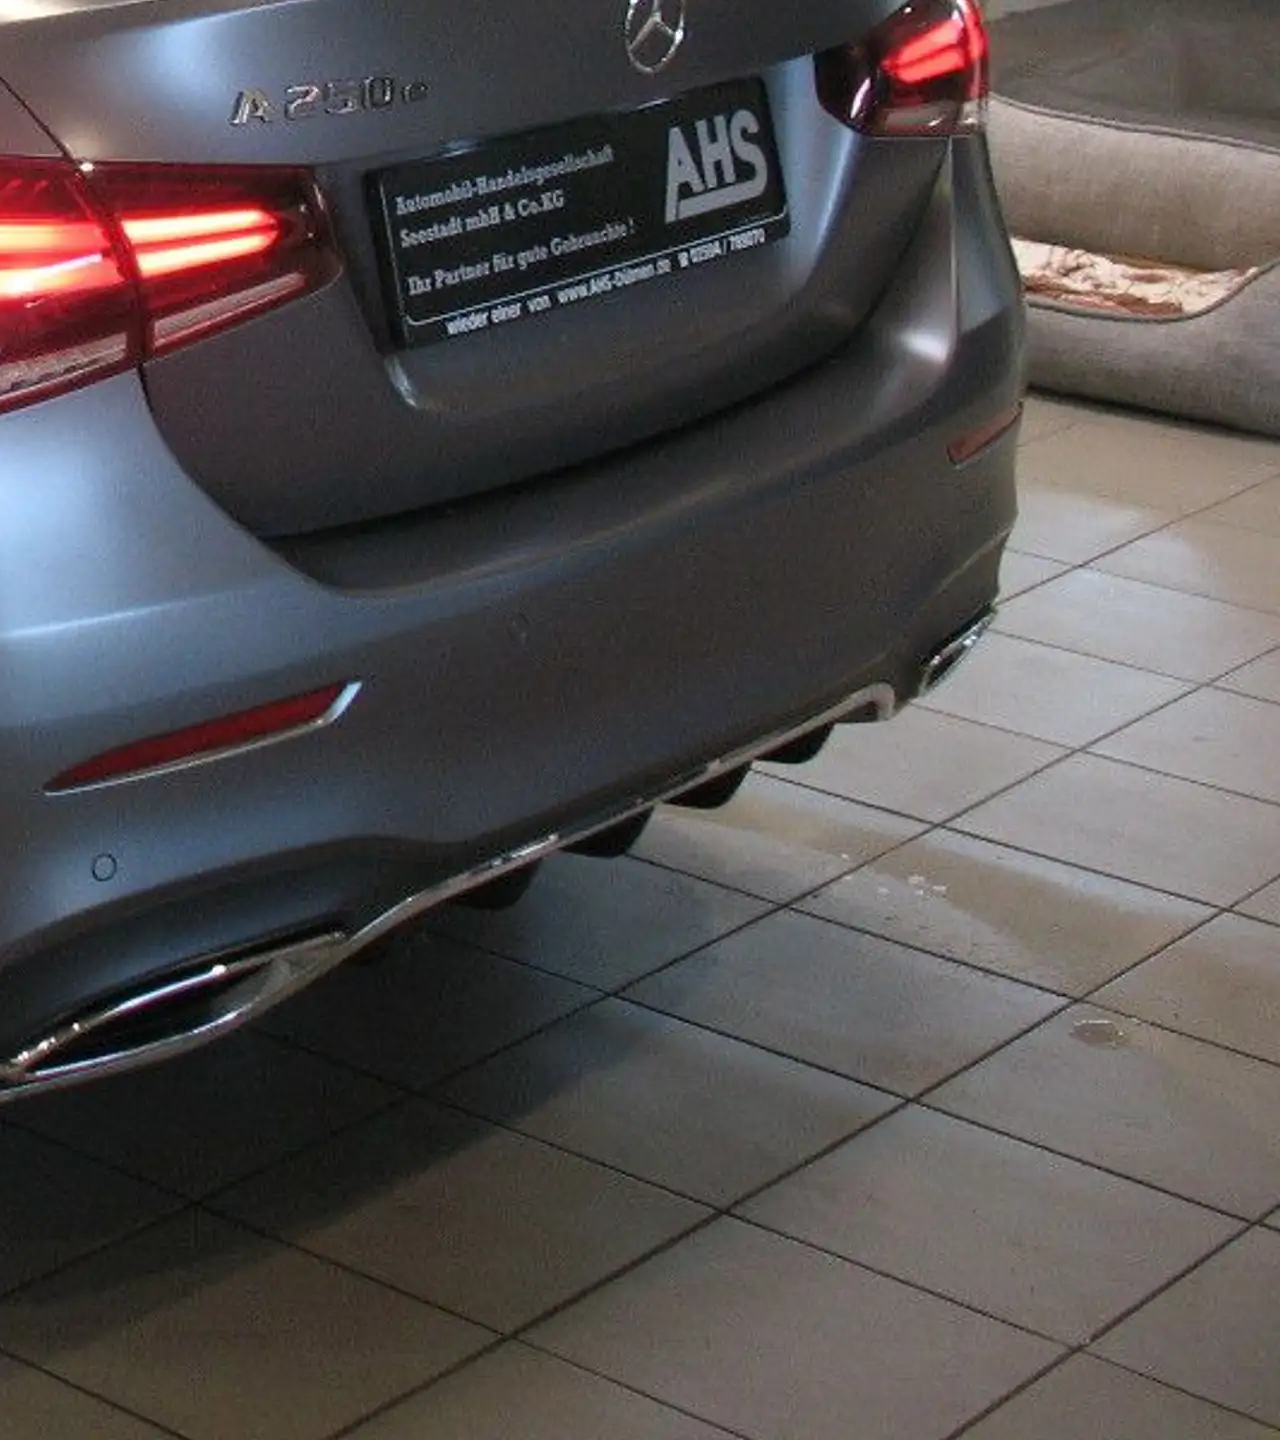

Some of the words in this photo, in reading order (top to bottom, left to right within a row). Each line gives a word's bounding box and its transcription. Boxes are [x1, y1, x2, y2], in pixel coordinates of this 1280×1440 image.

[396, 143, 615, 216] Automobil-Handelsgesellschaft
[664, 109, 768, 223] AHS
[399, 216, 463, 248] Seestadt
[465, 206, 500, 231] mbH
[502, 203, 515, 221] &
[407, 275, 432, 296] Ihr
[434, 260, 490, 290] Partner
[492, 252, 515, 273] für
[516, 245, 549, 271] gute
[446, 310, 489, 336] wieder
[490, 301, 523, 324] einer
[527, 293, 551, 313] von
